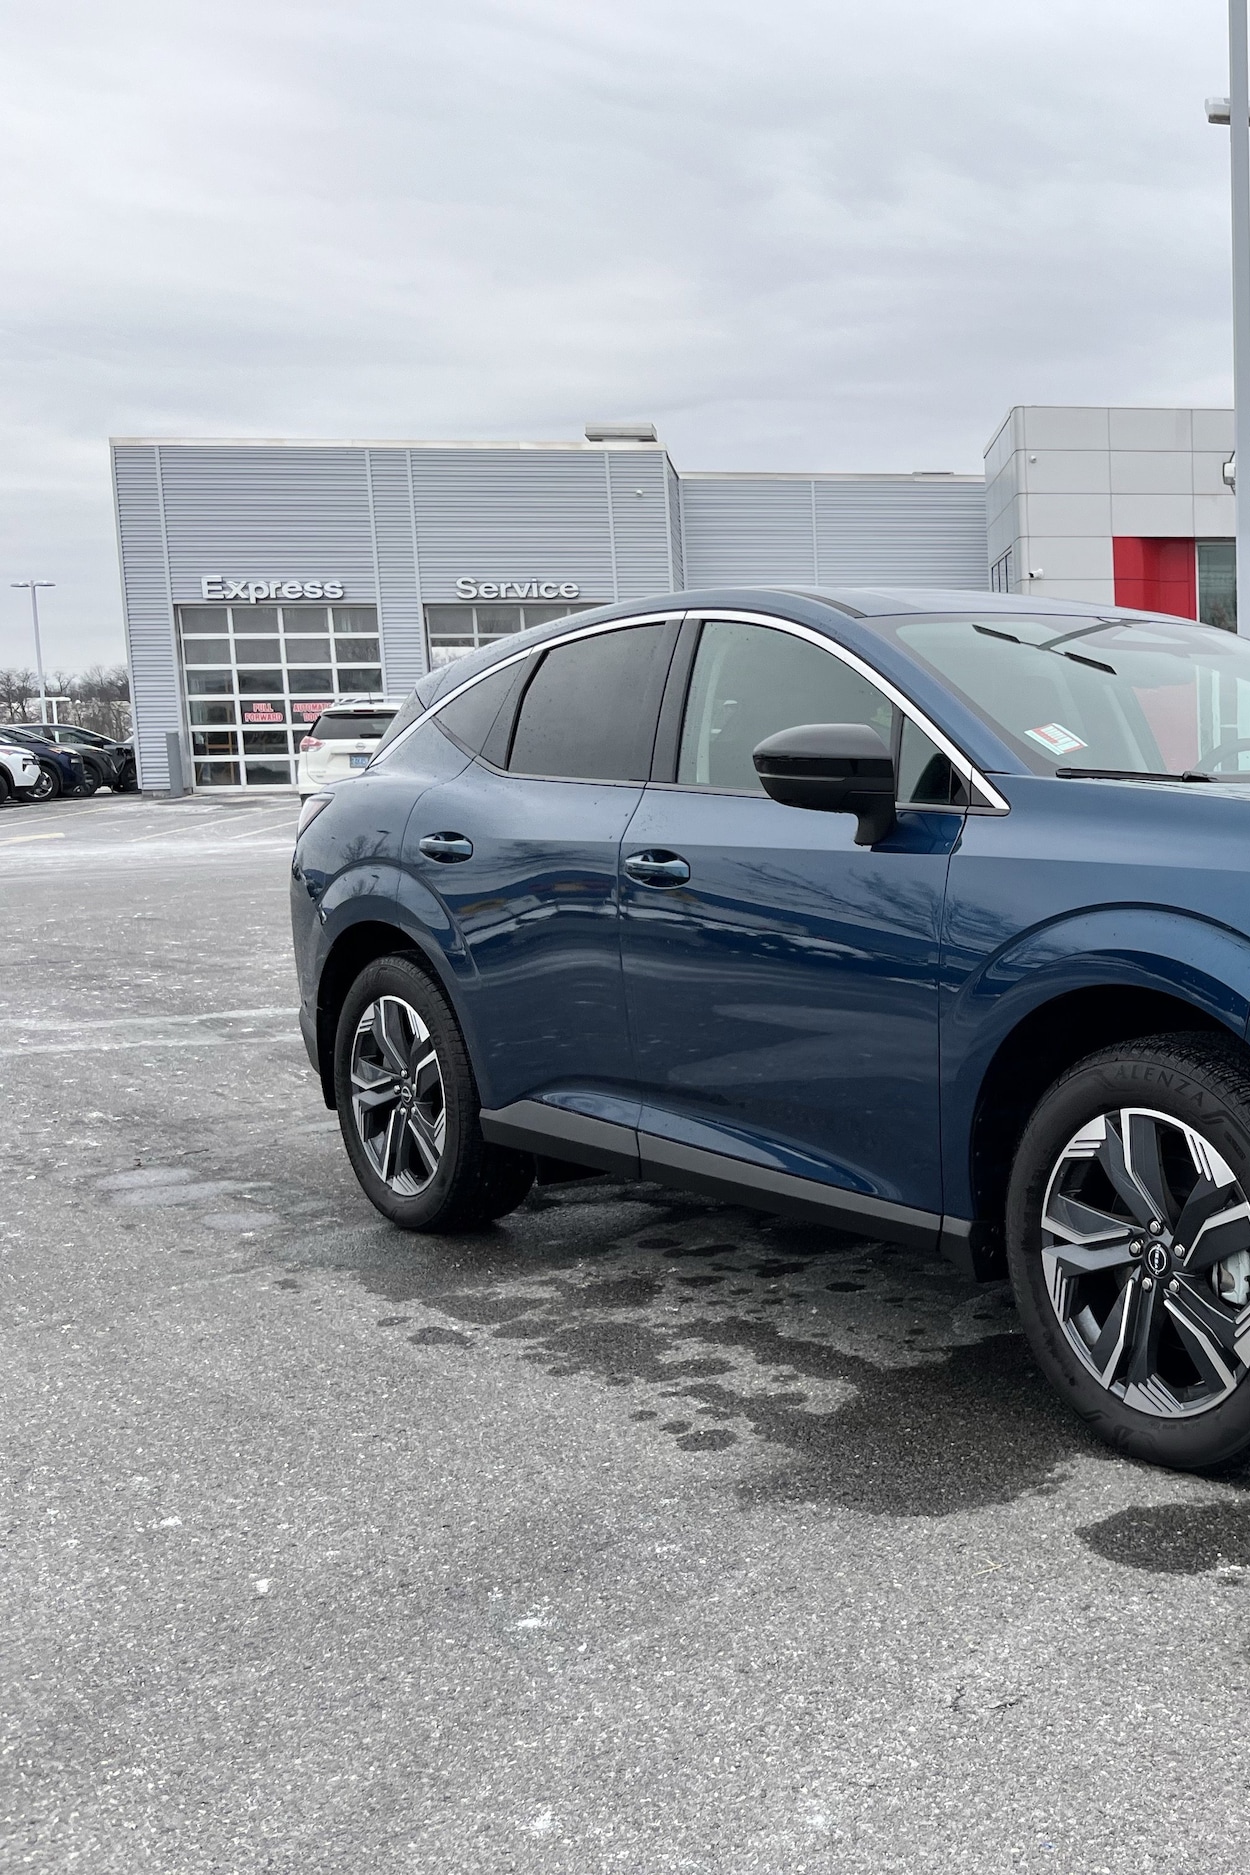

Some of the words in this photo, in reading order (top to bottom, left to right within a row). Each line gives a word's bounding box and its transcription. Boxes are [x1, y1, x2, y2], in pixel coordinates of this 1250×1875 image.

[201, 575, 344, 604] Express
[456, 577, 580, 600] Service
[244, 712, 284, 722] FORWARD
[253, 703, 273, 712] PULL
[1114, 1064, 1205, 1108] ALENZA
